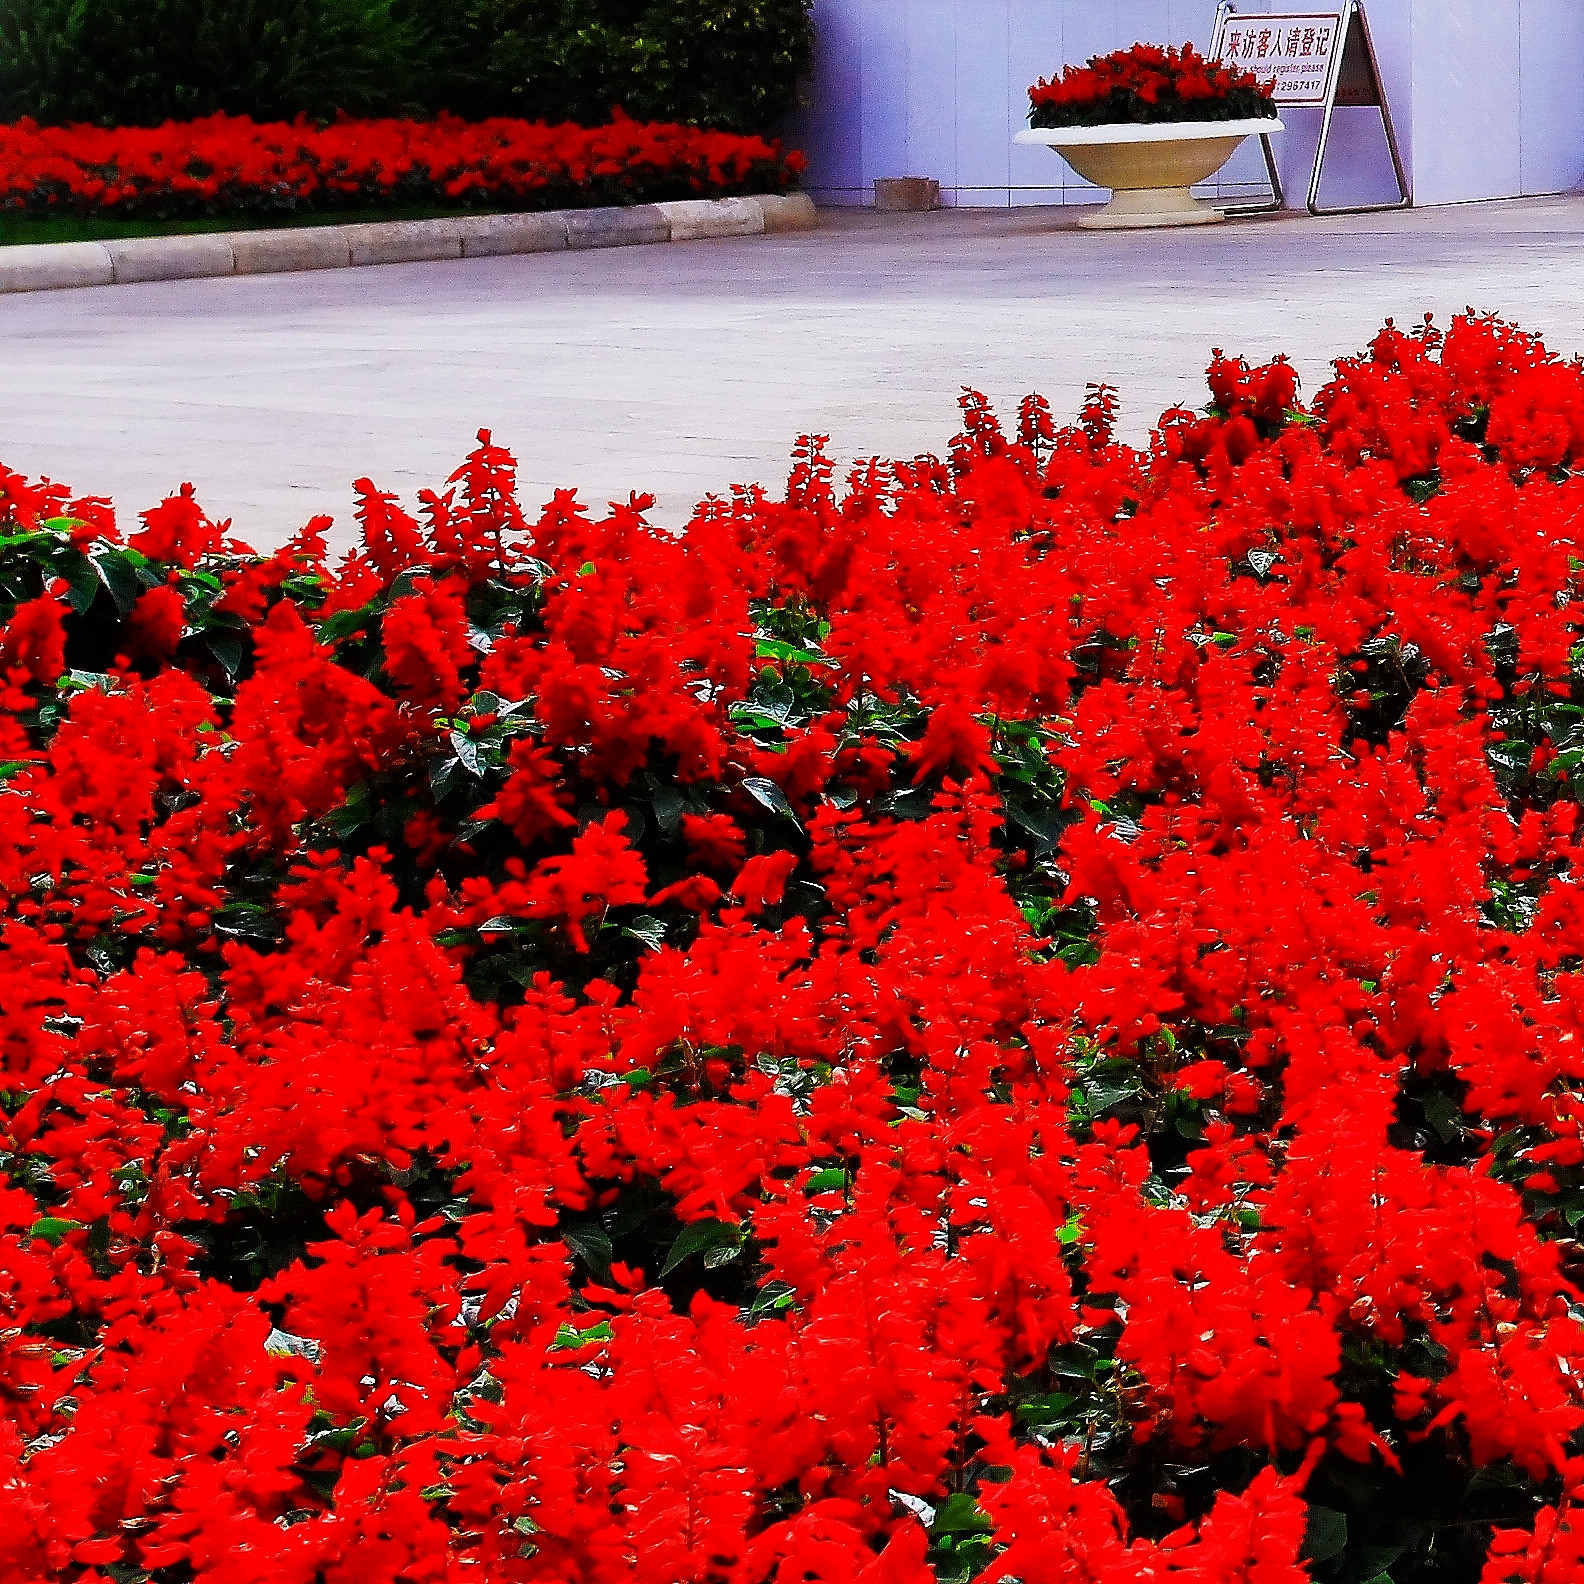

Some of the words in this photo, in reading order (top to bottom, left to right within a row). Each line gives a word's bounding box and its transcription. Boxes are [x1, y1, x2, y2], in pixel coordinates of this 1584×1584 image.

[1226, 27, 1330, 59] 来访客人请登记
